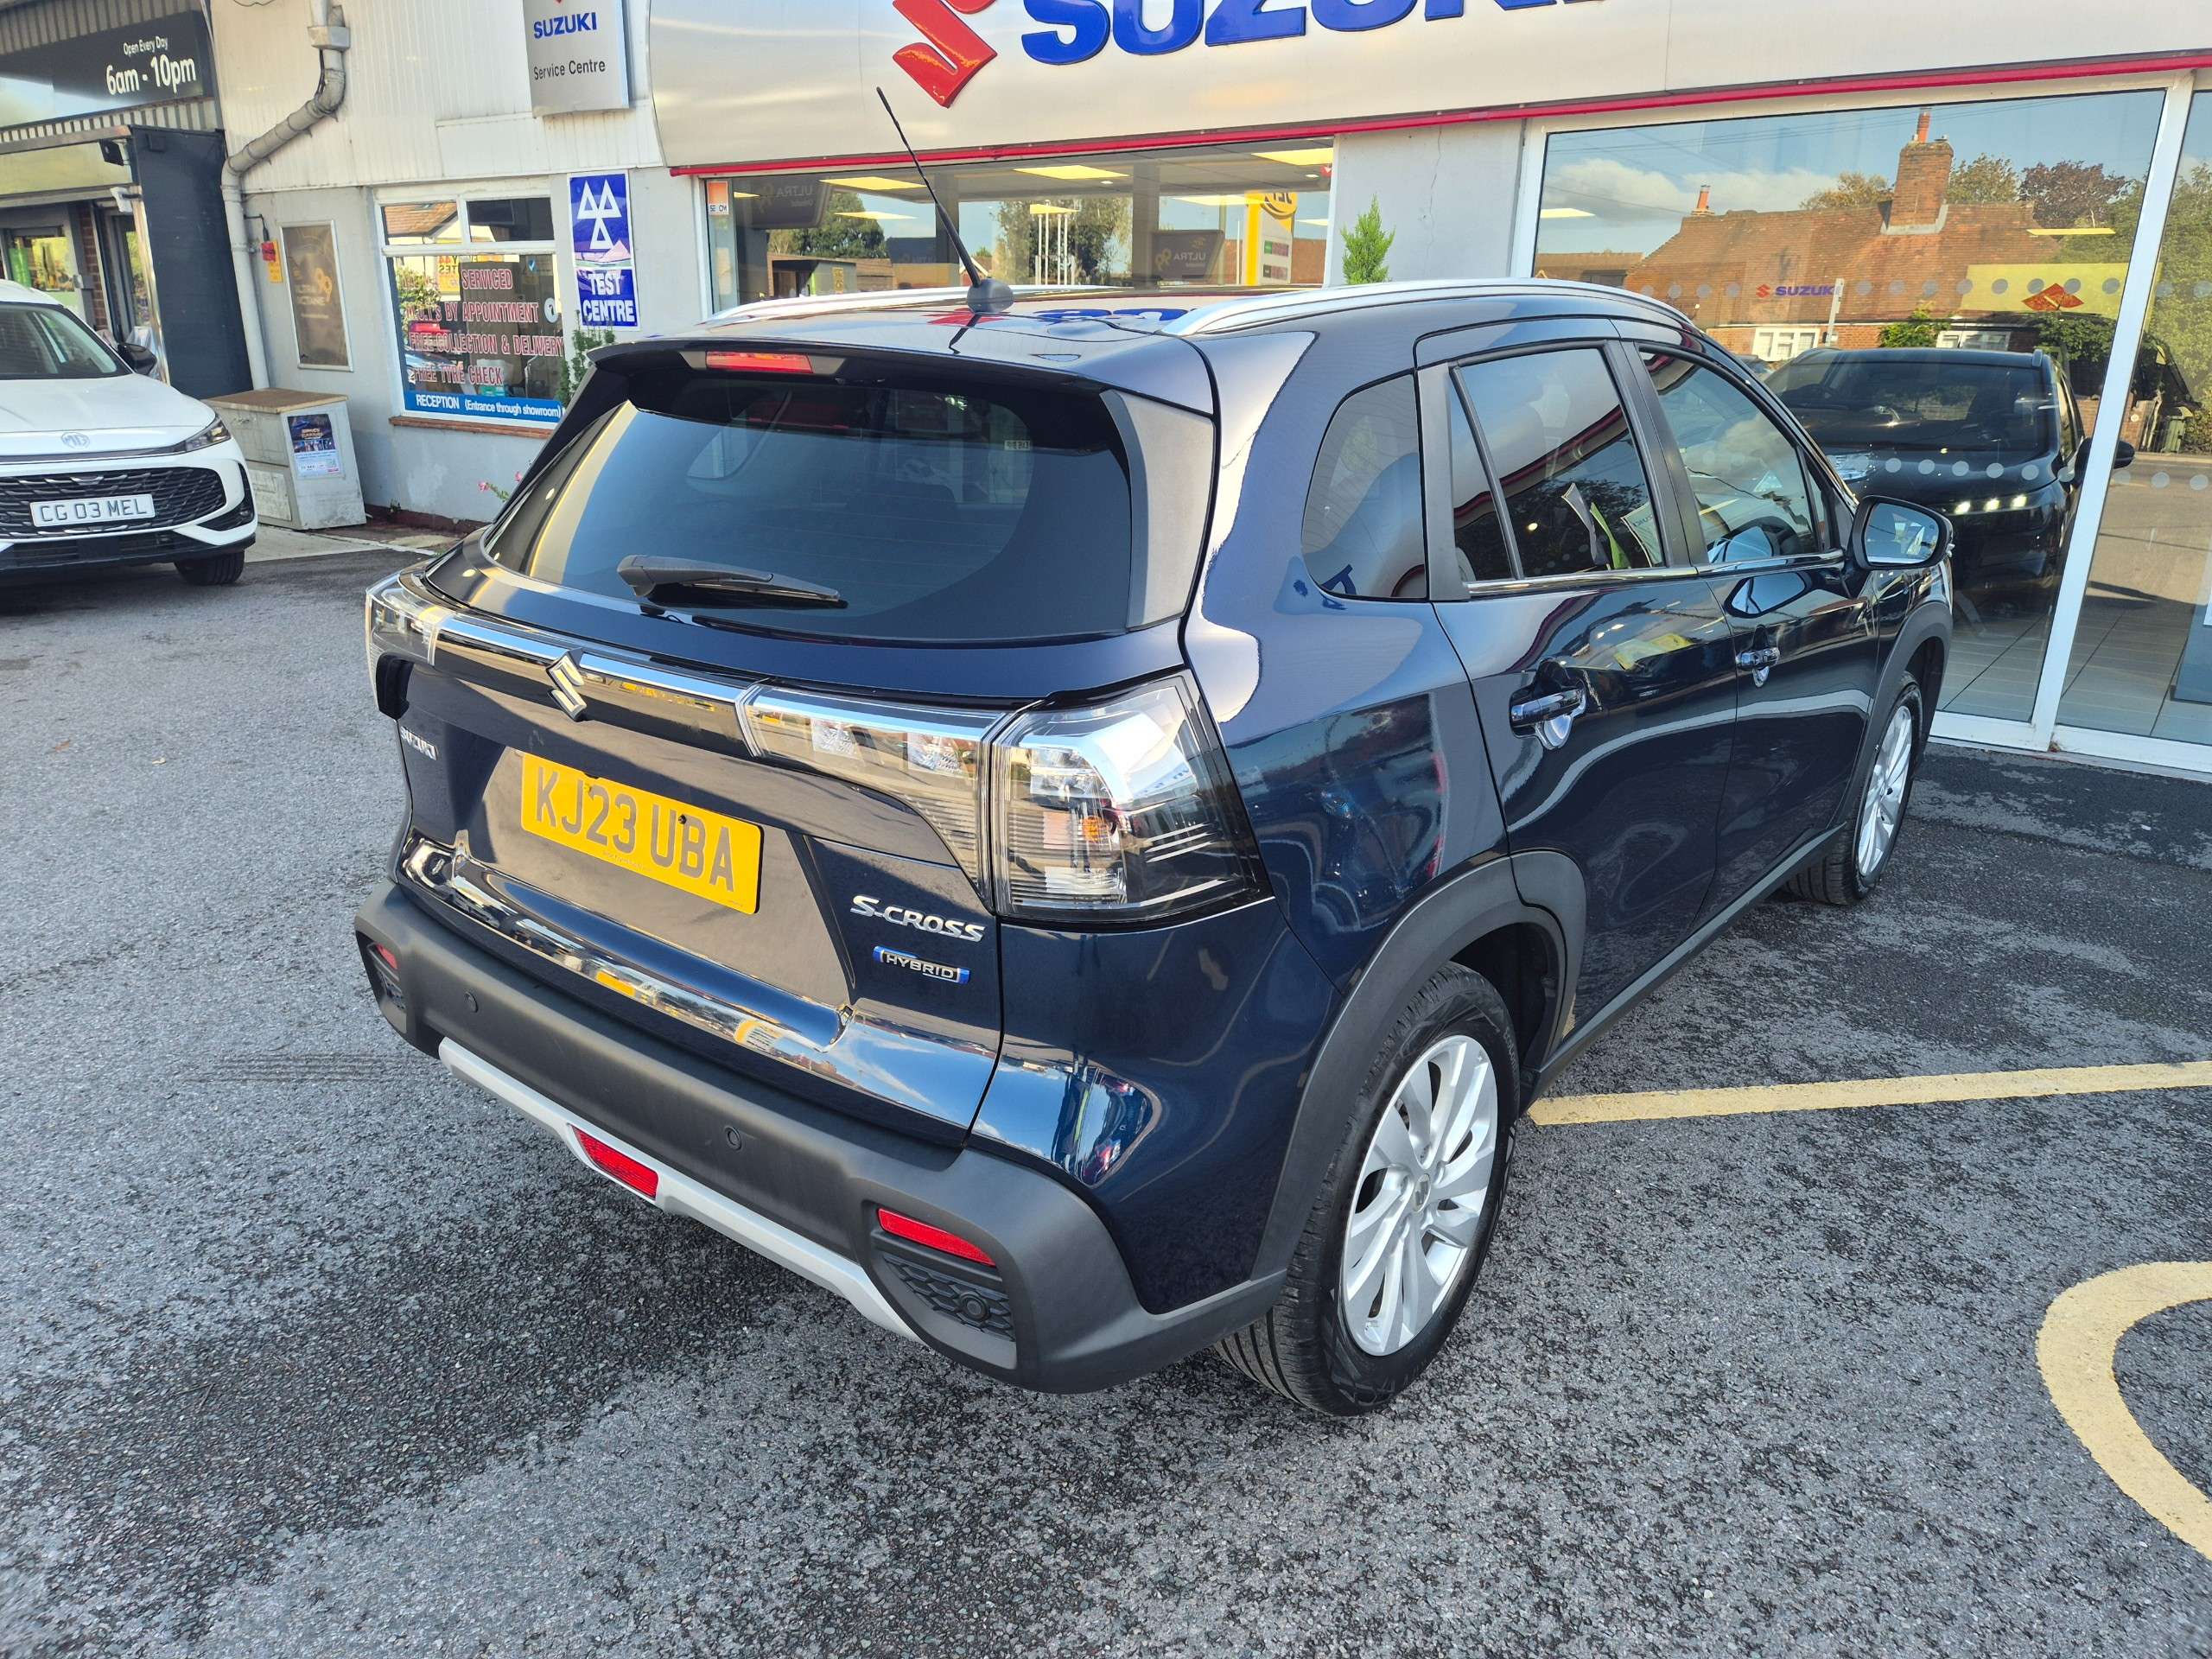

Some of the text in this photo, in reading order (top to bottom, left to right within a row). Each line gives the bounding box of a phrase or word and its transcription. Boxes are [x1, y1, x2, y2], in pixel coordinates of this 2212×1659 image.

[533, 12, 597, 39] SUZUKI
[123, 35, 168, 57] Open Every Day
[106, 64, 139, 95] 6am
[150, 54, 197, 93] 10pm
[533, 60, 606, 80] Service Centre
[461, 269, 512, 289] SERVICED
[588, 273, 621, 296] TEST
[444, 302, 458, 321] BY
[462, 302, 539, 323] APPOINTMENT
[583, 299, 636, 322] CENTRE
[436, 333, 498, 354] COLLECTION
[501, 336, 511, 354] &
[513, 335, 564, 357] DELIVERY
[441, 365, 467, 384] TYRE
[468, 365, 504, 385] CHECK
[416, 393, 460, 410] RECEPTION
[464, 401, 496, 412] (Entrance
[496, 403, 524, 416] through
[523, 406, 562, 417] showroom)
[41, 505, 67, 522] CG
[107, 498, 147, 517] MEL
[536, 766, 734, 893] KJ23 UBA
[849, 894, 988, 942] S-CROSS
[886, 953, 954, 978] HYBRID
